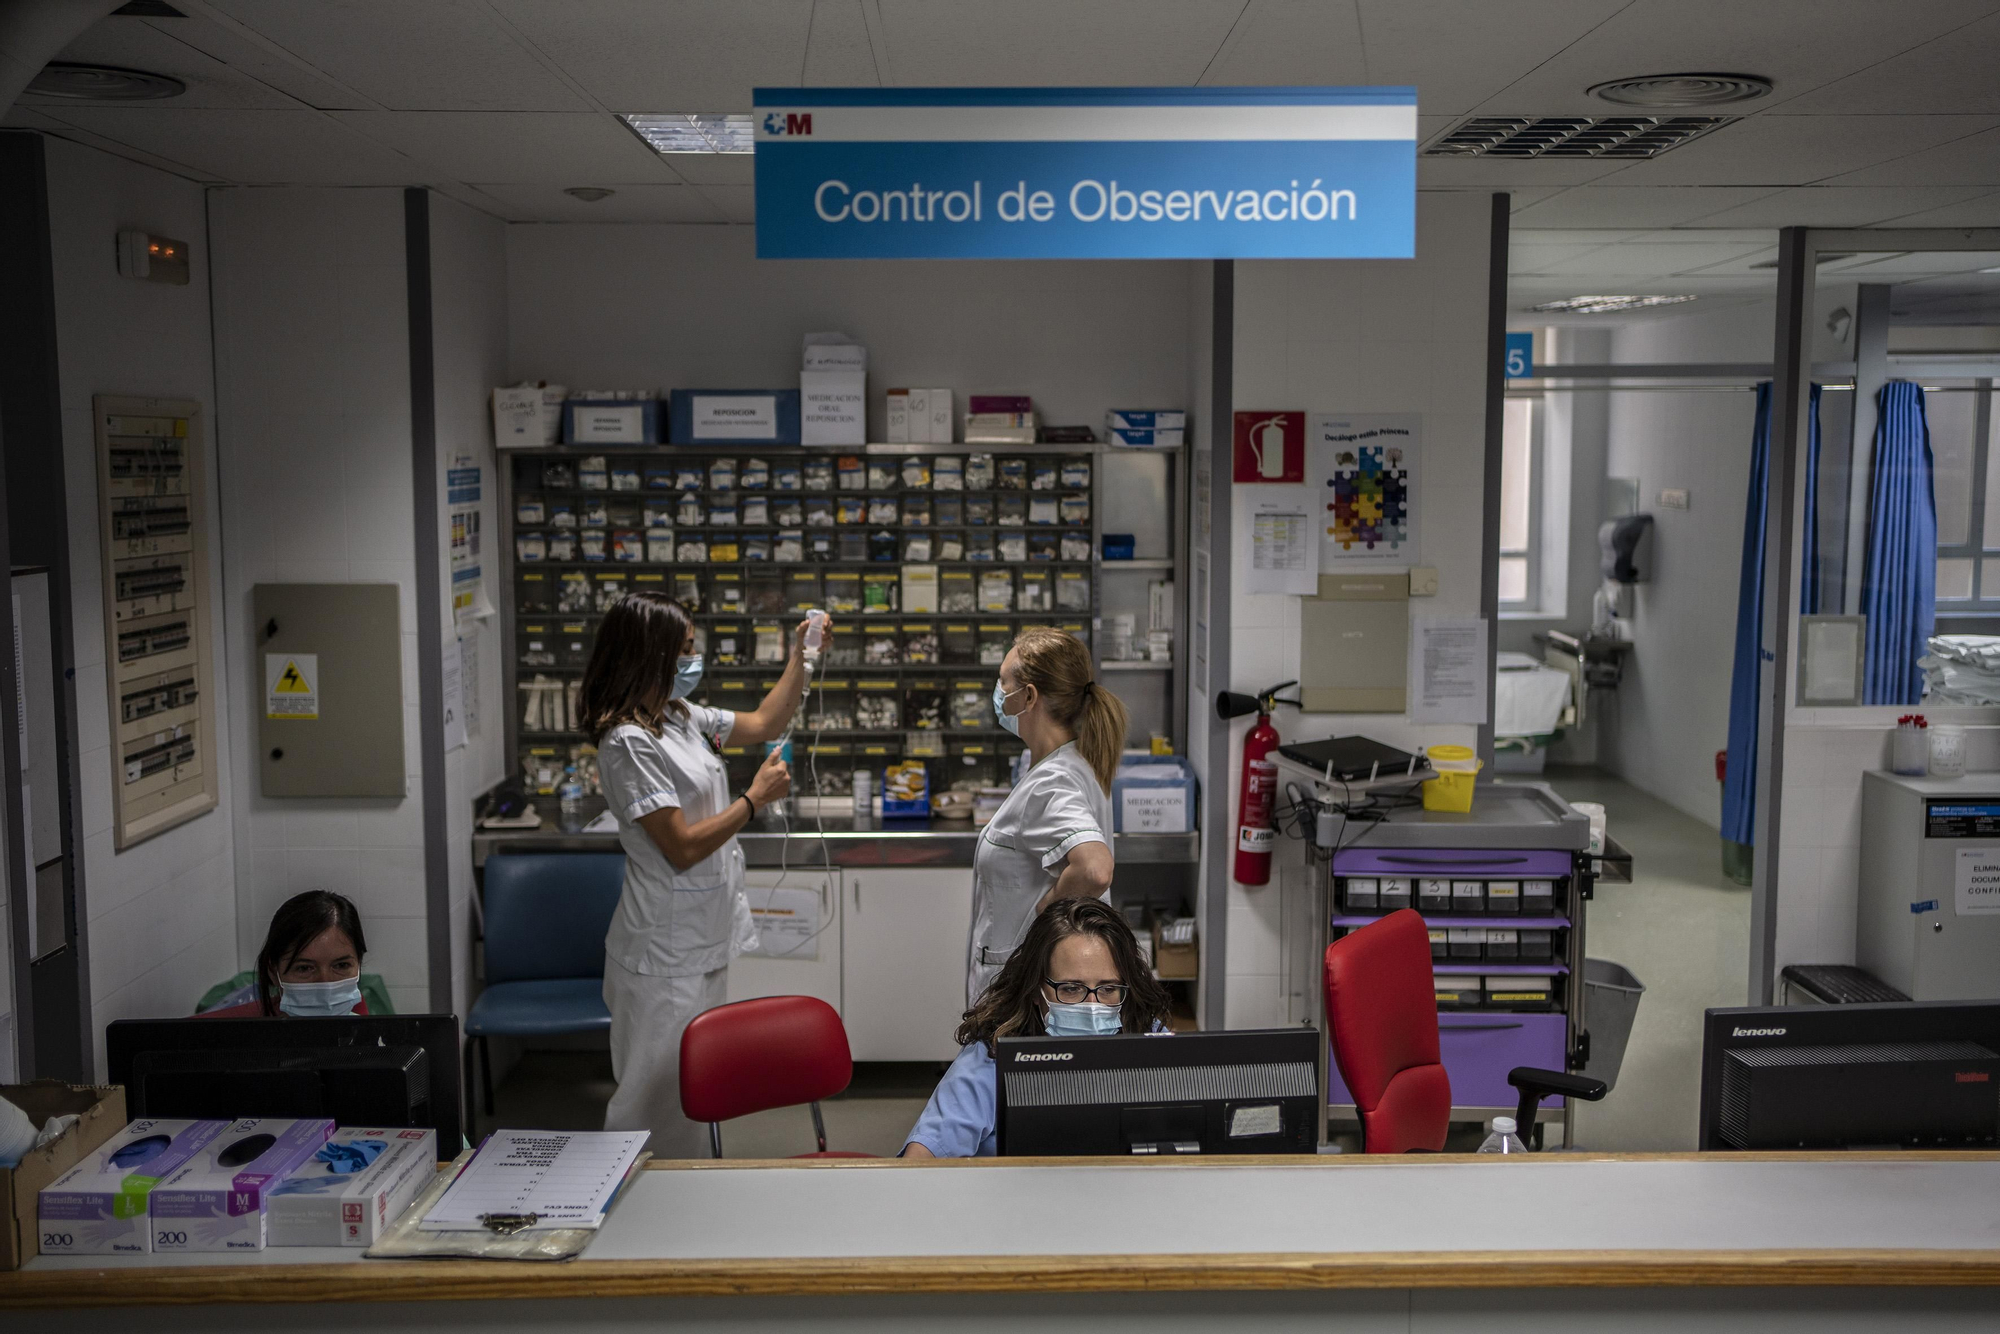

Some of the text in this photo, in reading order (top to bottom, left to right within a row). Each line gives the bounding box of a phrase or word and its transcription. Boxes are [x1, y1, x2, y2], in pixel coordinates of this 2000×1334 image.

[786, 113, 812, 136] M
[814, 178, 1357, 223] Control de Observación
[1506, 348, 1524, 376] 5
[1324, 428, 1410, 442] Decálogo estilo Princesa
[1126, 798, 1183, 806] MEDICACION
[1386, 880, 1400, 893] 2
[1429, 880, 1440, 893] 3
[1462, 884, 1474, 897] 4
[1732, 1026, 1787, 1037] lenovo
[1014, 1052, 1073, 1062] lenovo
[43, 1195, 104, 1205] Sensiflex Lite
[157, 1193, 217, 1203] Sensiflex Lite
[235, 1193, 250, 1206] M
[349, 1225, 358, 1235] S
[43, 1233, 73, 1246] 200
[157, 1231, 187, 1244] 200
